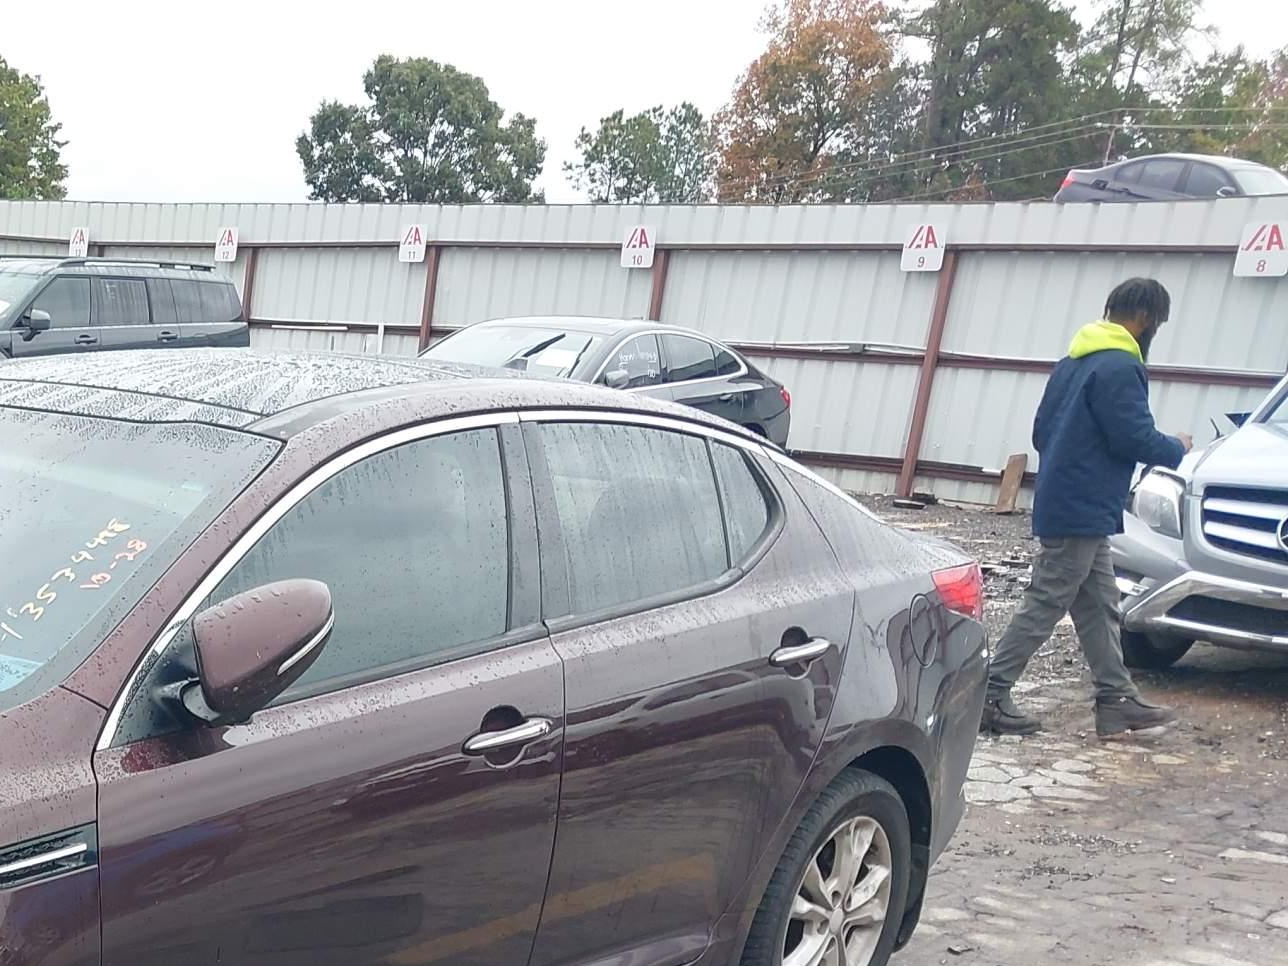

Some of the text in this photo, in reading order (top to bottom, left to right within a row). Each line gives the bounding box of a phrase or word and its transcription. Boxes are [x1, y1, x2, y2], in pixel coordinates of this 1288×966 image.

[632, 255, 643, 266] 10
[917, 256, 925, 268] 9
[1255, 259, 1267, 273] 8
[80, 538, 147, 589] 10-28
